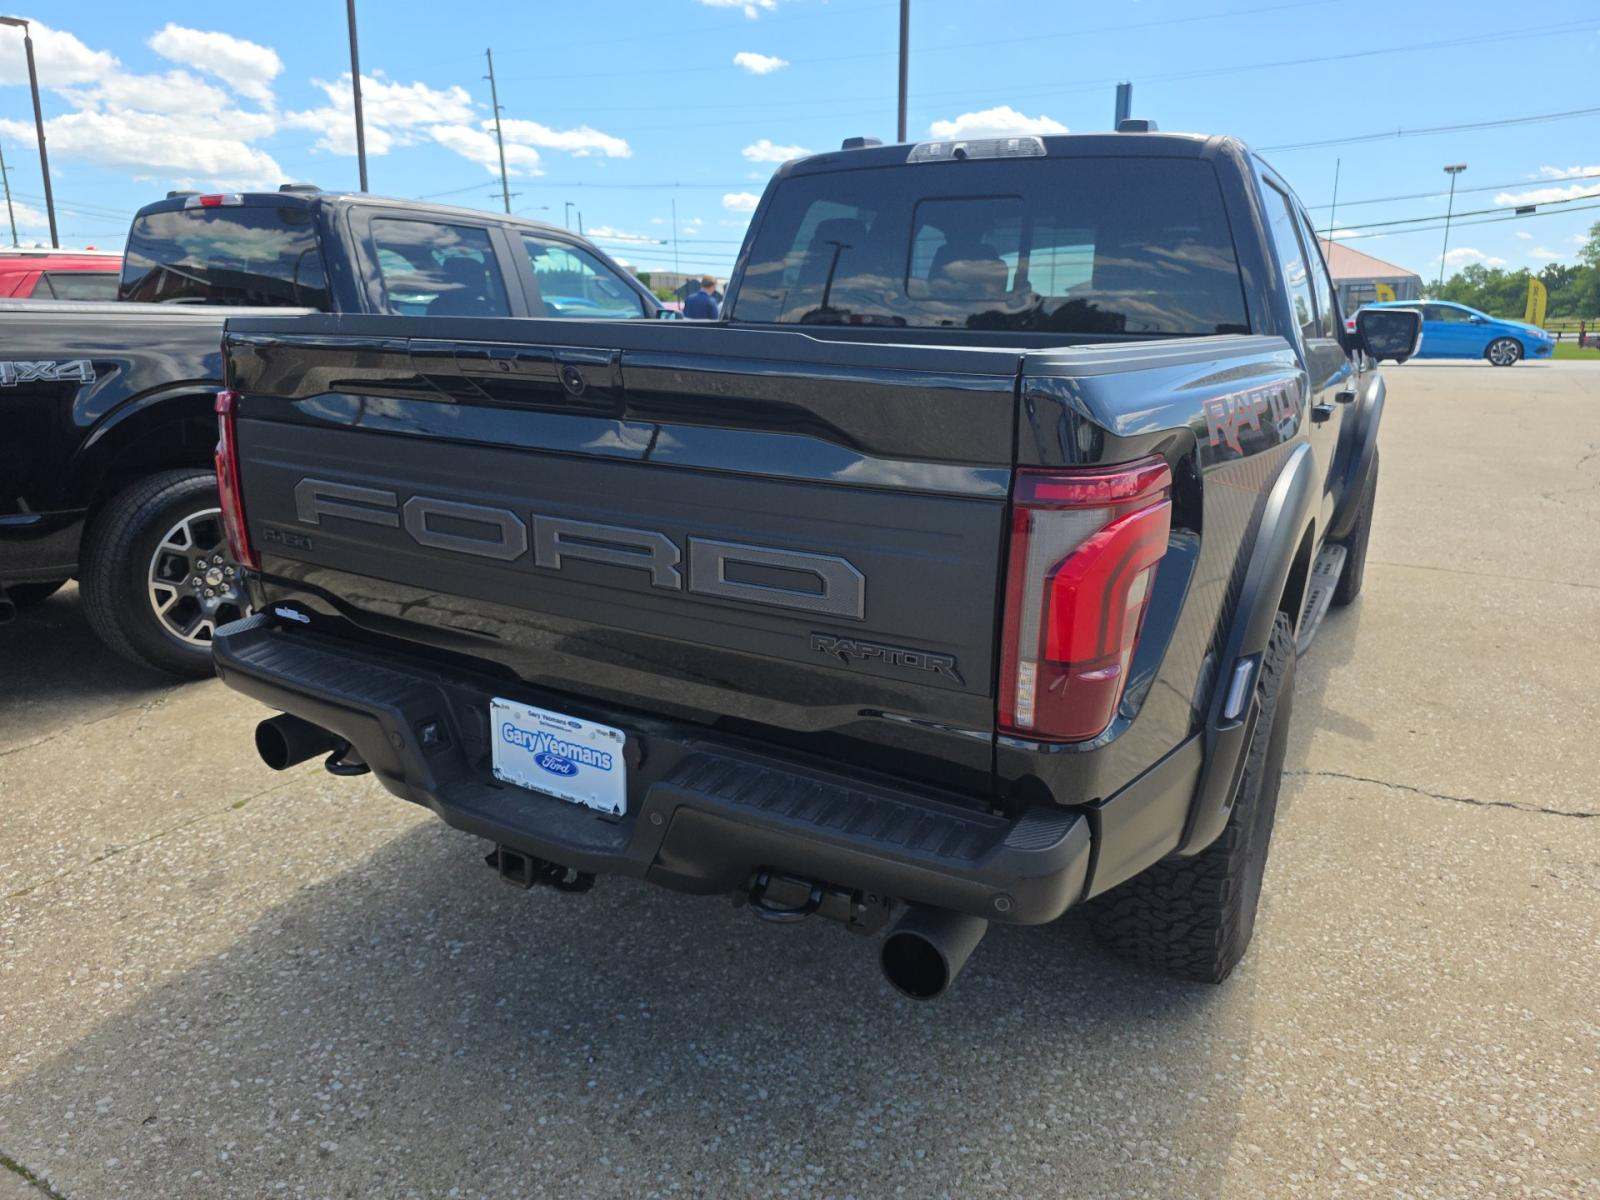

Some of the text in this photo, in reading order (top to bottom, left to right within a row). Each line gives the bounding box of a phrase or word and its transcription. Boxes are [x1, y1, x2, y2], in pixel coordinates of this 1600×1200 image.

[294, 477, 867, 621] FORD
[810, 631, 966, 686] RAPTOR
[502, 722, 612, 771] Gary Yeomans
[541, 754, 571, 775] Ford
